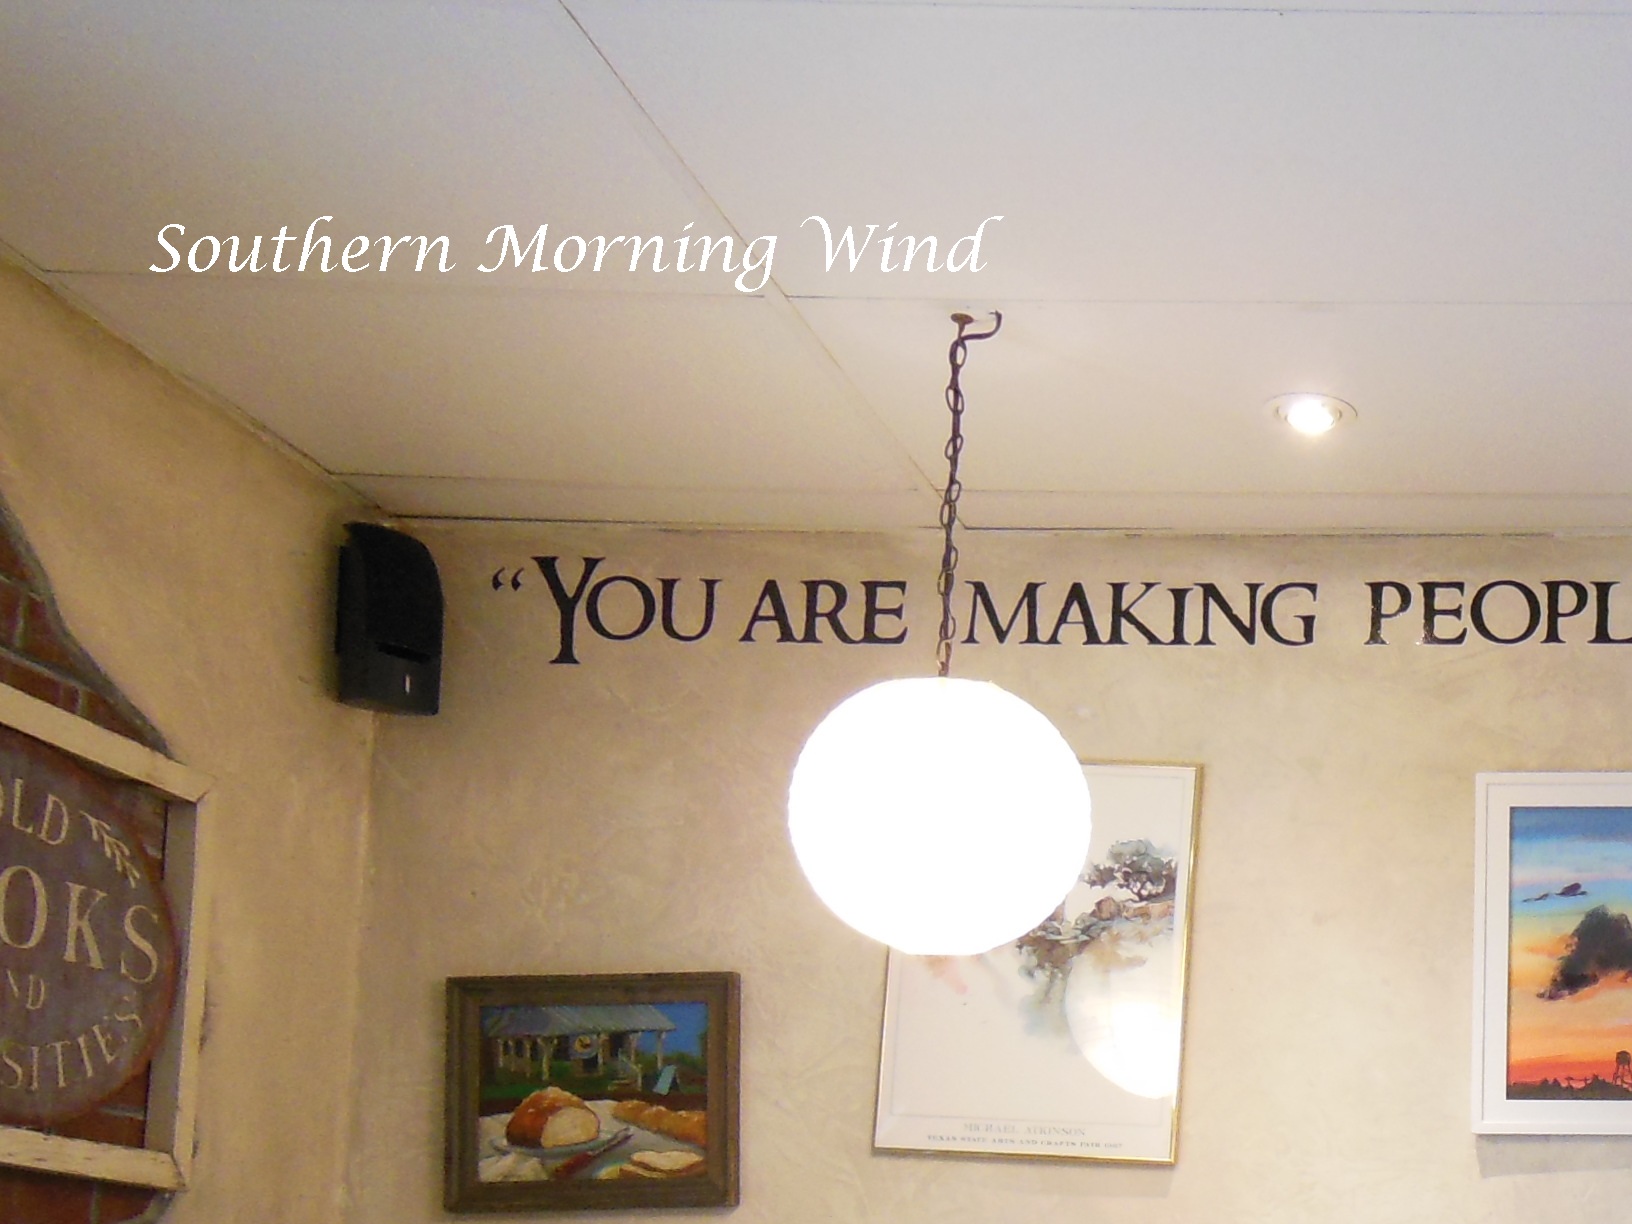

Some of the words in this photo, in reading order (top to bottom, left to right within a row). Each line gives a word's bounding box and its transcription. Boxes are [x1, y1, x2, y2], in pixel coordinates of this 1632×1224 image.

[738, 579, 908, 644] ARE
[962, 581, 1319, 647] MAKING
[0, 778, 69, 846] LD
